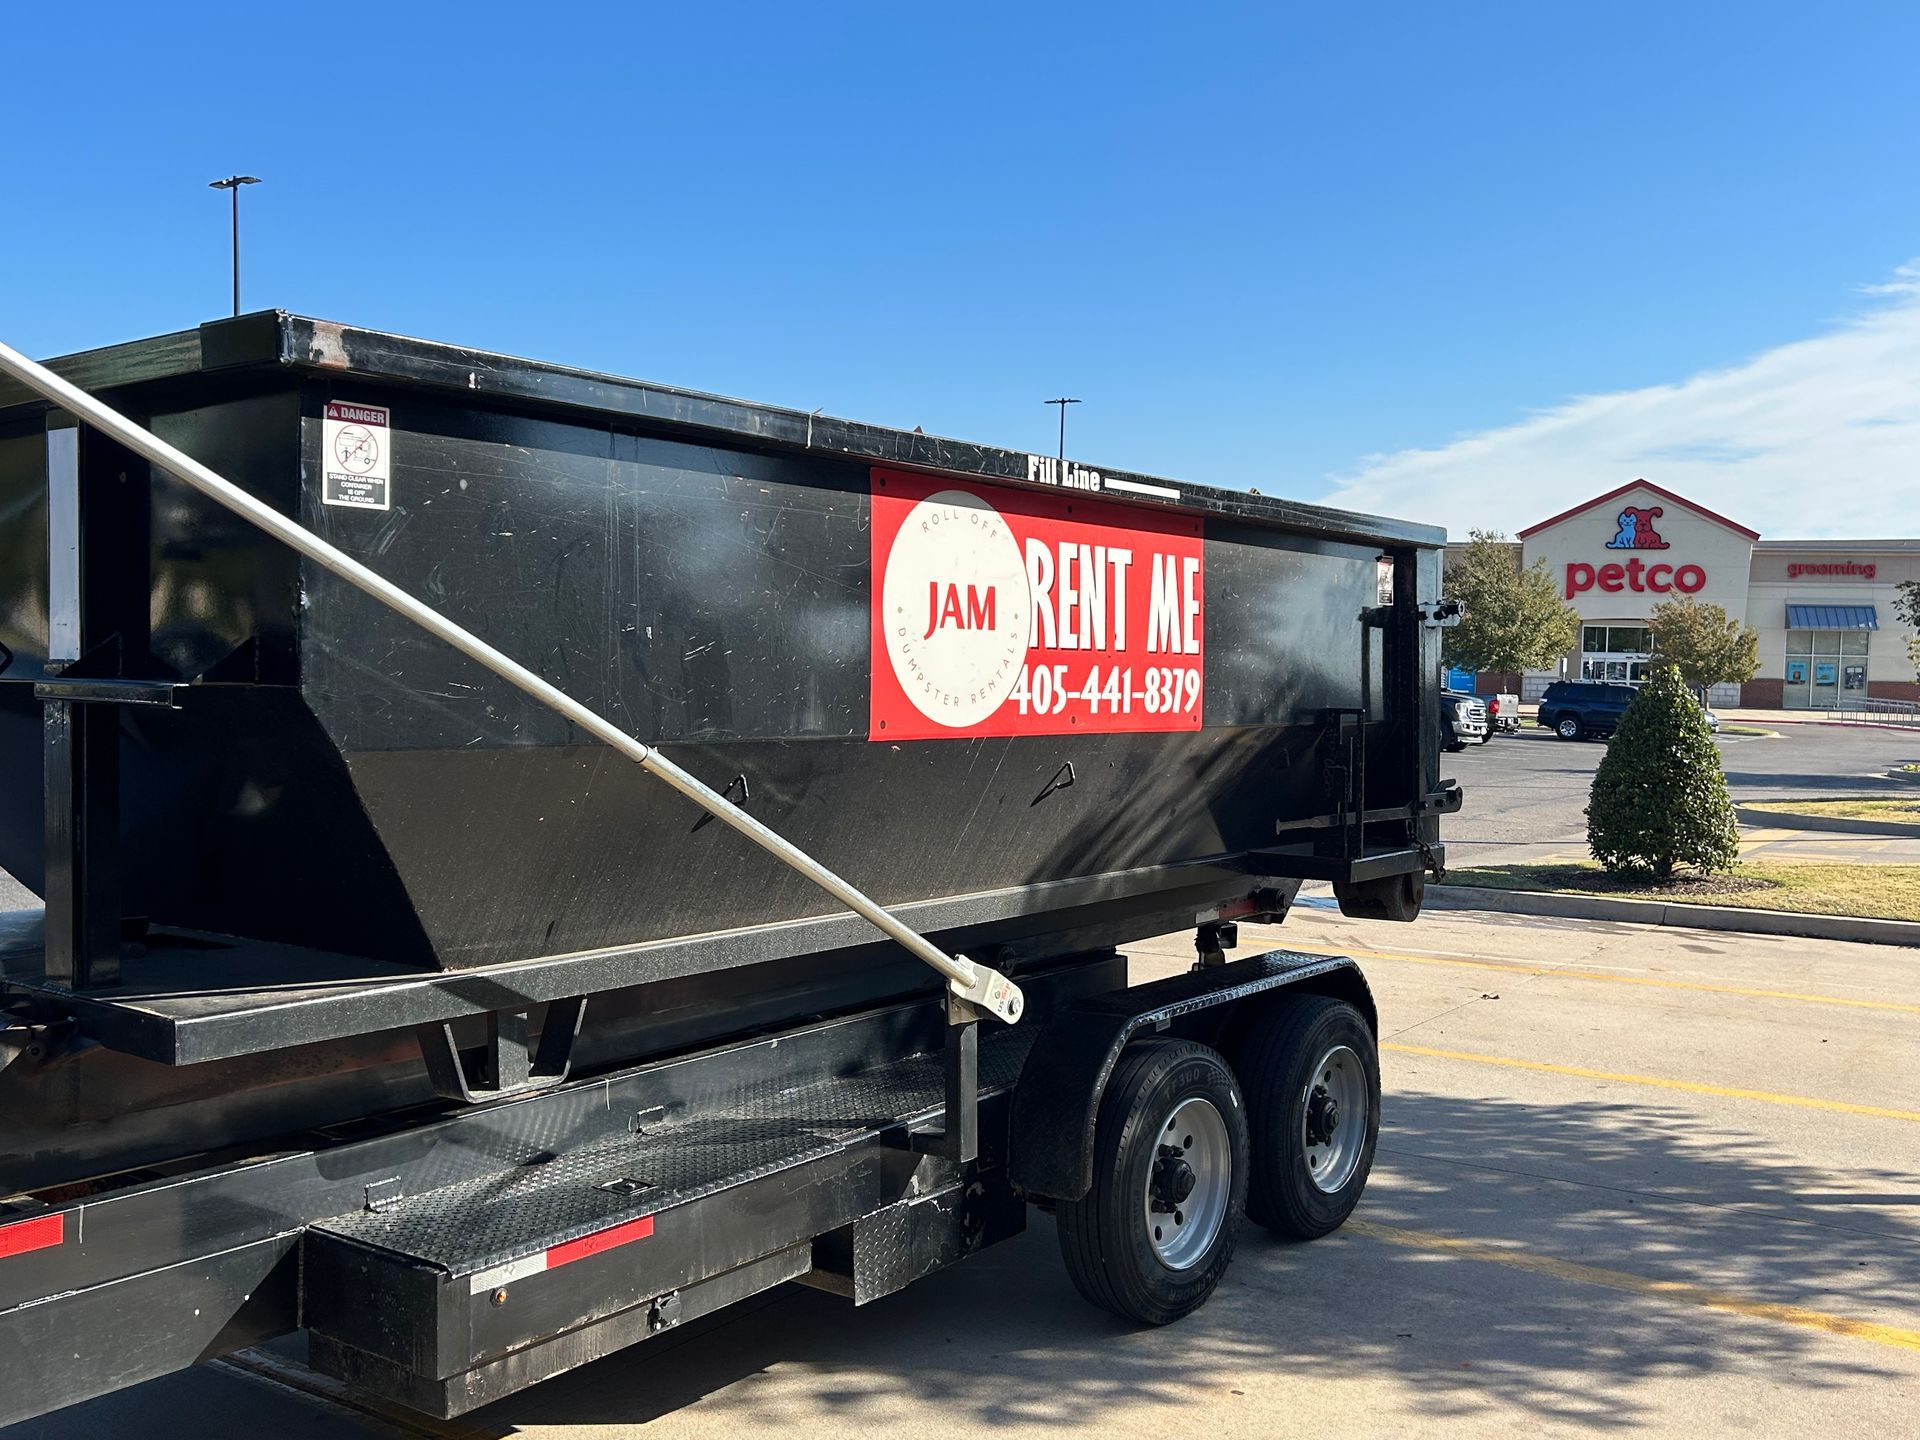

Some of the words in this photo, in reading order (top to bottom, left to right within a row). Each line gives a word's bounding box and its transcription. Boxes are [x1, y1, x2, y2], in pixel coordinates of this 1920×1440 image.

[340, 406, 385, 424] DANGER
[340, 481, 373, 490] CONTAINER
[1027, 454, 1058, 486] Fill
[1062, 460, 1101, 492] Line
[921, 509, 959, 534] ROLL
[970, 513, 998, 539] OFF
[1565, 557, 1707, 601] petco
[1787, 560, 1876, 579] grooming
[923, 581, 996, 641] JAM
[1025, 537, 1133, 652] RENT
[1147, 552, 1201, 655] ME
[898, 627, 960, 708] DUMPSTER
[970, 631, 1018, 705] RENTALS
[1007, 663, 1201, 716] 405-441-8379
